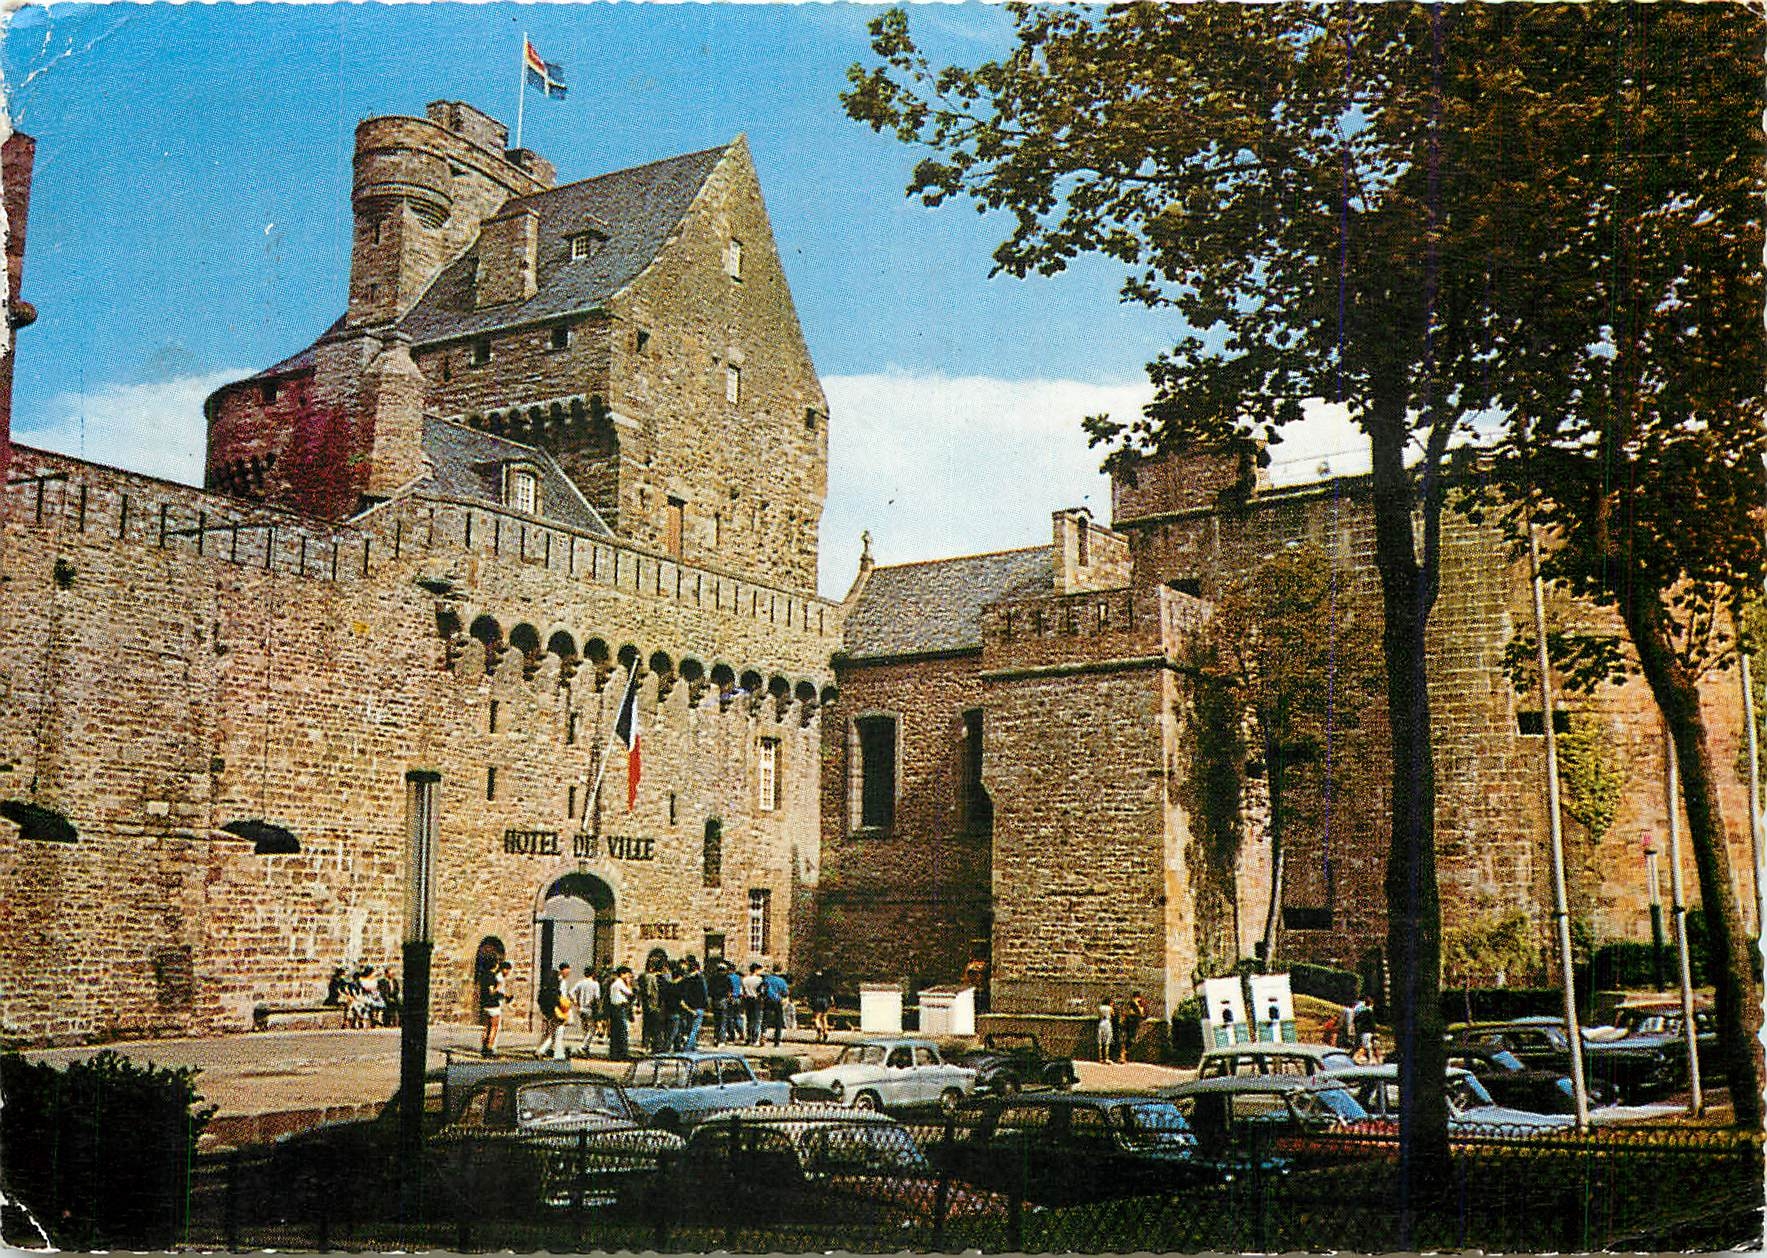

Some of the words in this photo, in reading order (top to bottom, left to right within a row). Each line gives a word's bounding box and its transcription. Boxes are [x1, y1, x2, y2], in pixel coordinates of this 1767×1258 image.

[504, 829, 560, 855] HOTEL
[573, 834, 599, 858] DE
[607, 835, 655, 860] VILLE
